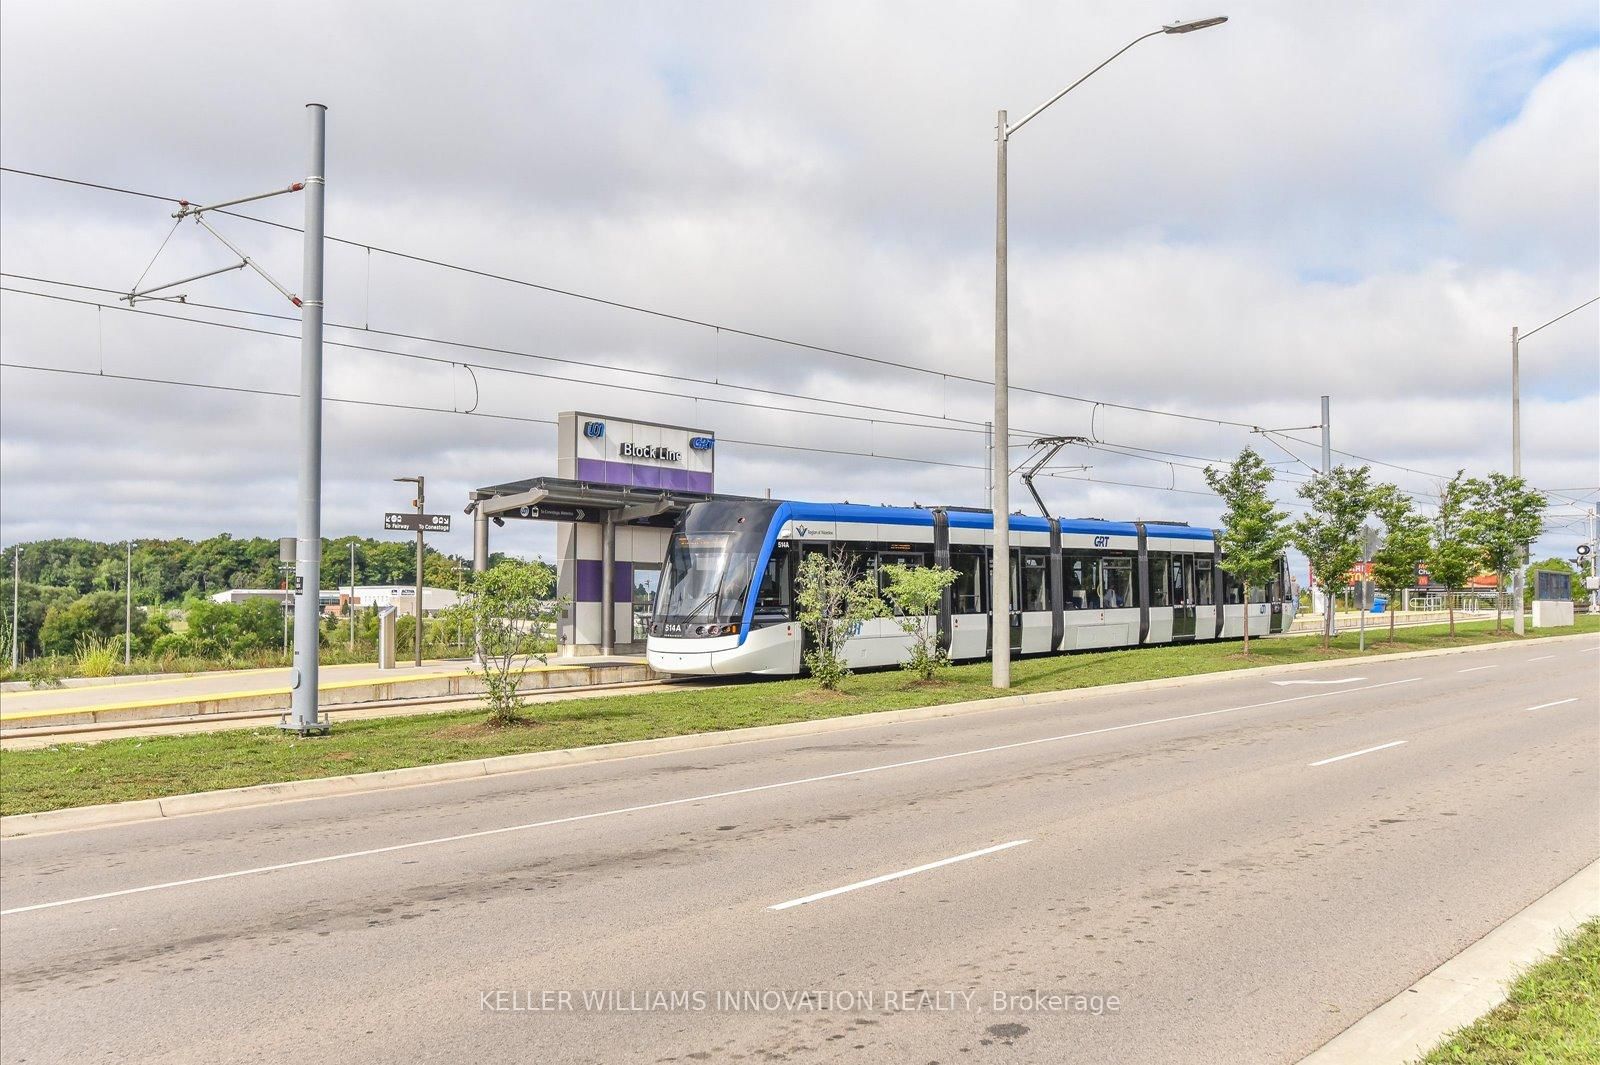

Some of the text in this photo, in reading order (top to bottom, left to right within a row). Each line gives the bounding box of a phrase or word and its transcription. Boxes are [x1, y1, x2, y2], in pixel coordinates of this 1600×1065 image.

[624, 442, 681, 461] Block Line
[1094, 536, 1110, 548] GRT
[665, 624, 682, 632] 514A
